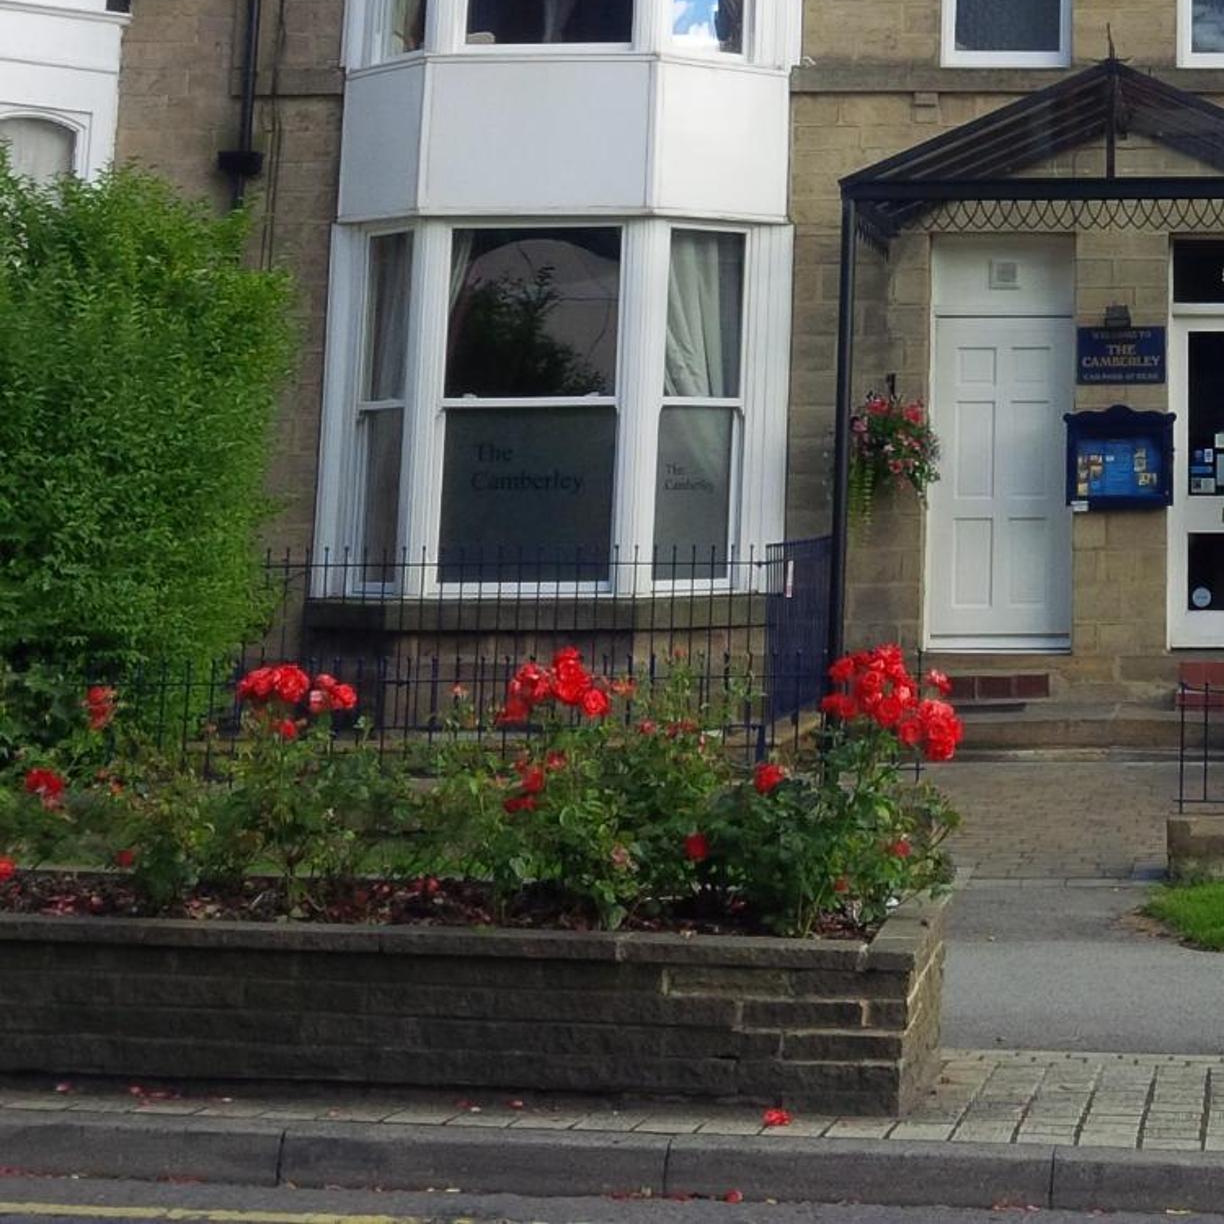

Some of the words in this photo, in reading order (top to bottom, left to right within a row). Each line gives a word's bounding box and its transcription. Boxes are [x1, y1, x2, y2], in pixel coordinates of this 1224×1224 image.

[1105, 343, 1137, 355] THE
[1081, 355, 1161, 367] CAMBERLEY
[472, 442, 514, 462] The
[471, 468, 585, 496] Camberley
